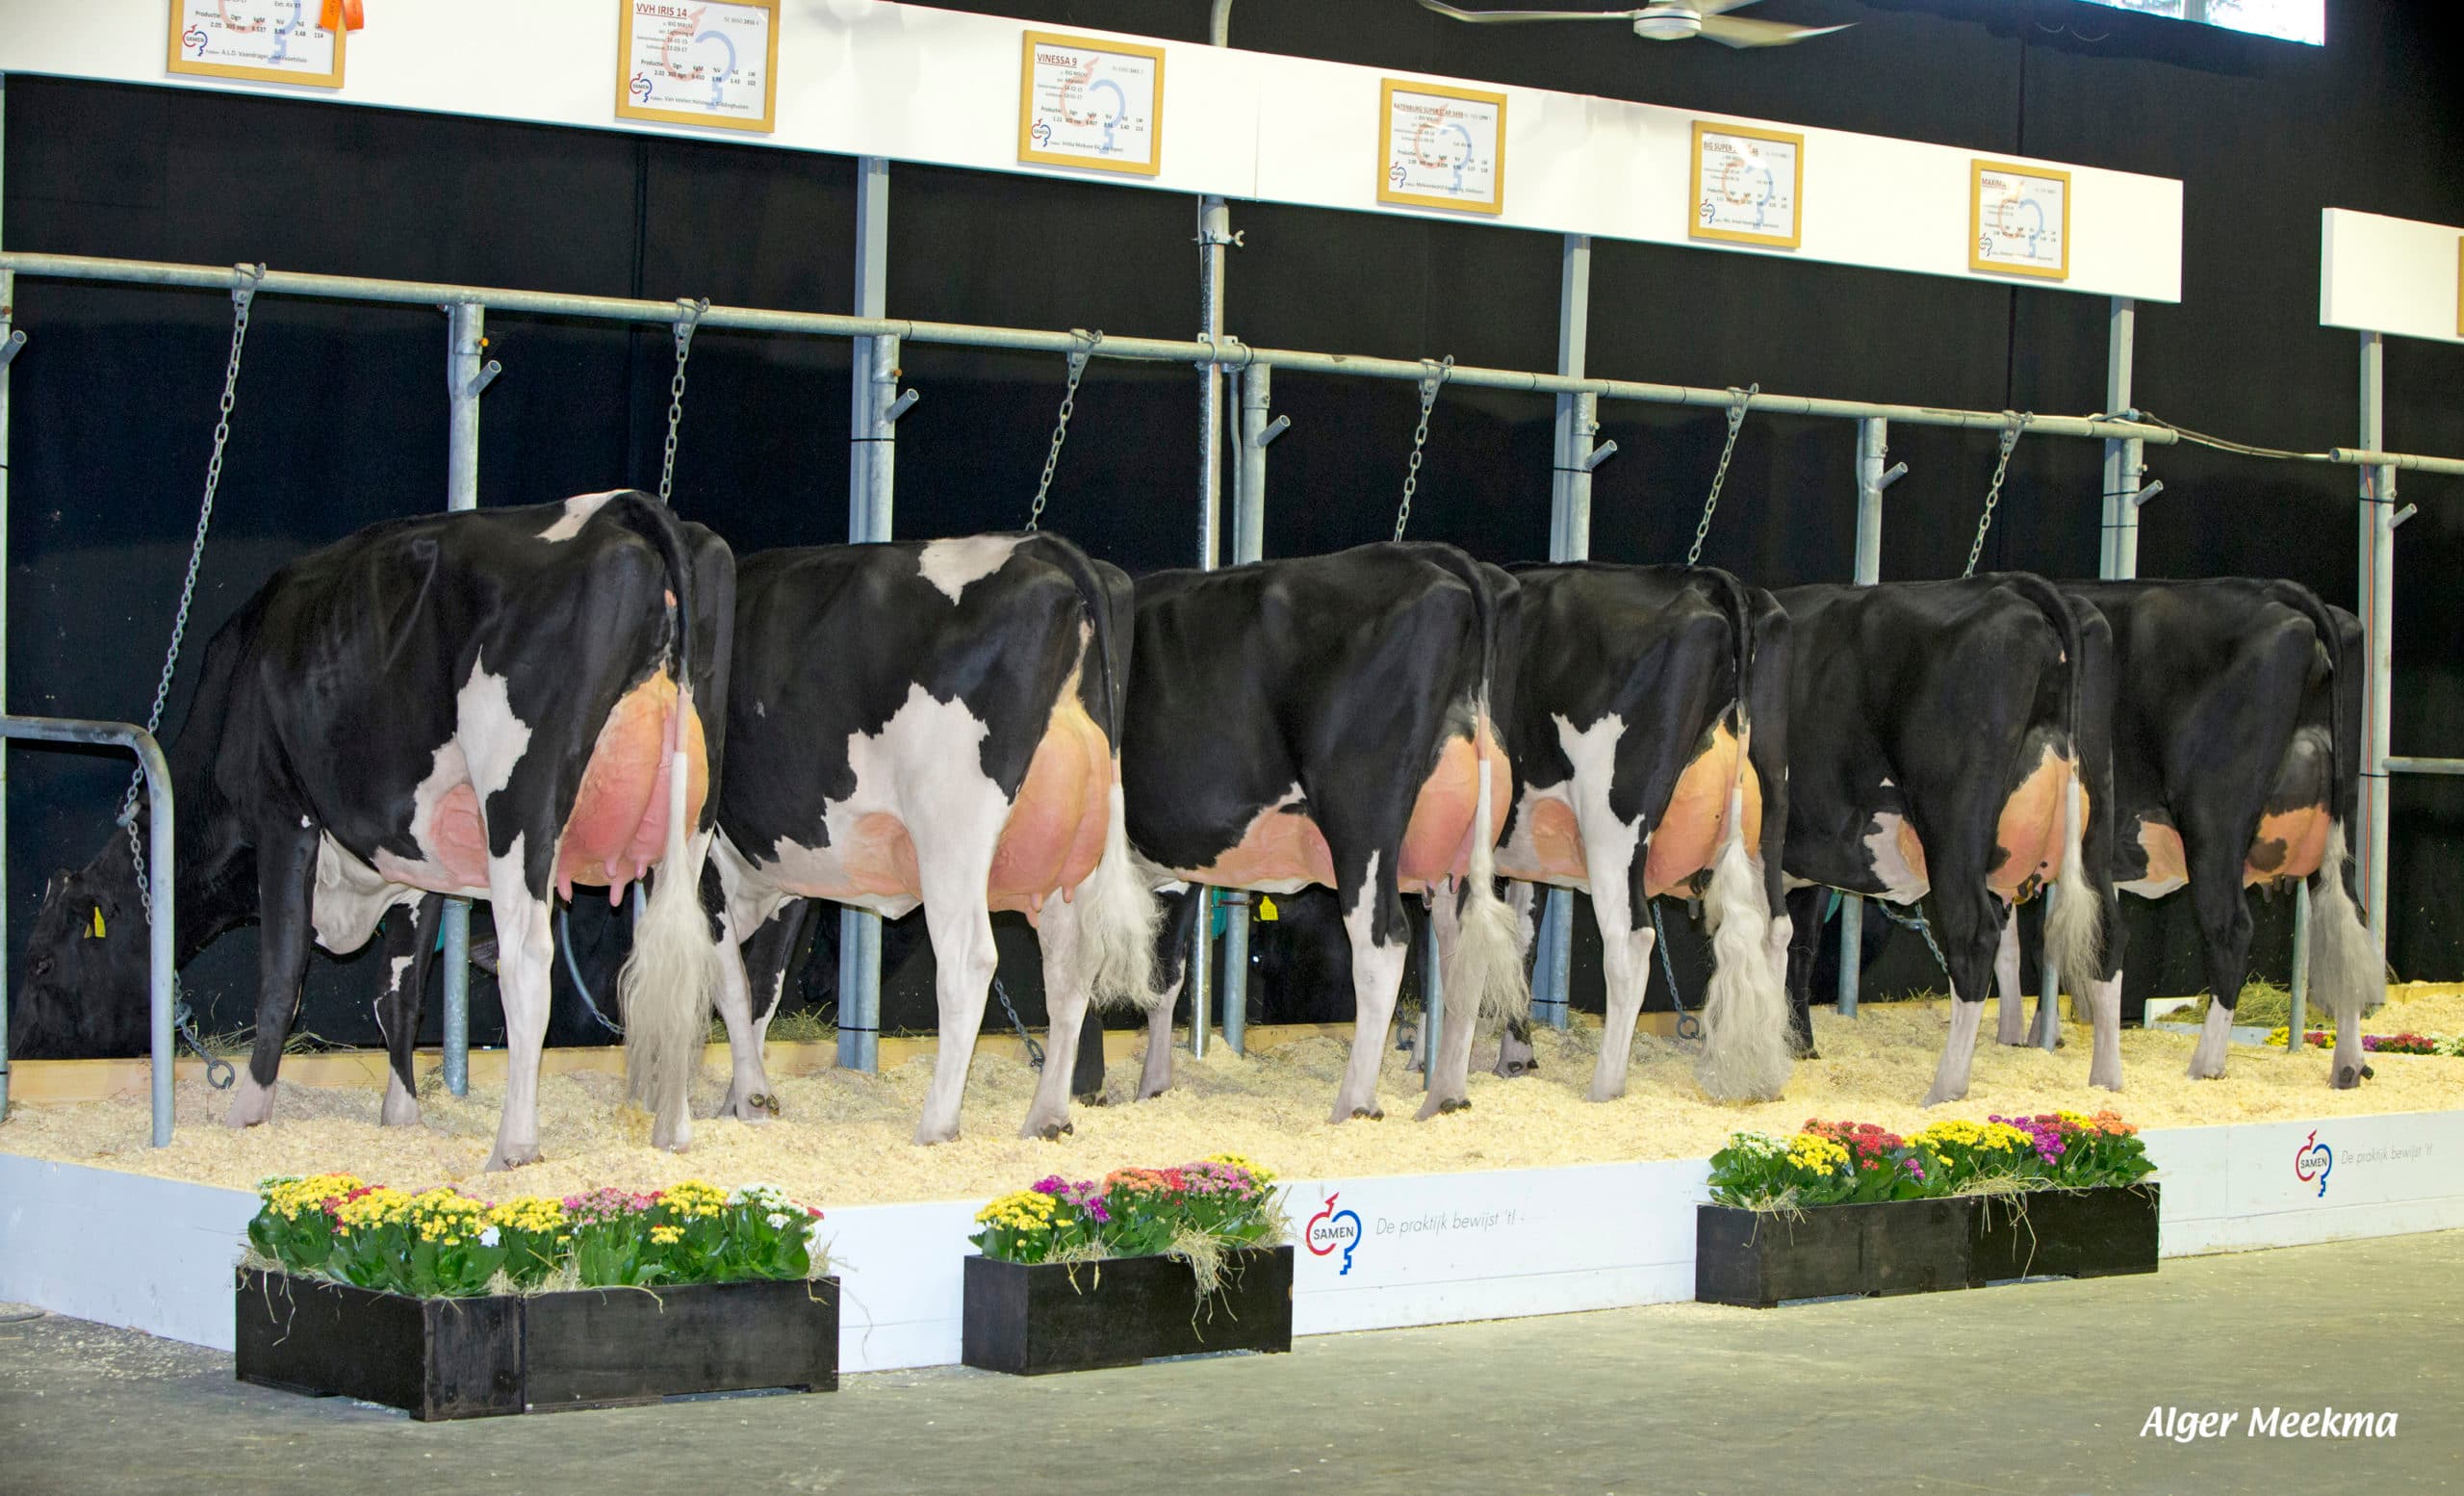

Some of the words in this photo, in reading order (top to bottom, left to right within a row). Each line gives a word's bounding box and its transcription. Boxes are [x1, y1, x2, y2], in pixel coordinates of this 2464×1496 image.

[636, 3, 655, 13] VVH
[658, 6, 675, 16] IRIS
[677, 8, 687, 17] 14
[1037, 53, 1070, 65] VINESSA
[1072, 58, 1078, 66] 9
[2300, 1157, 2327, 1169] SAMEN
[2341, 1149, 2353, 1164] De
[1376, 1217, 1396, 1235] De
[1399, 1212, 1448, 1240] praktijk
[1452, 1210, 1500, 1232] bewijst
[1313, 1226, 1354, 1241] SAMEN
